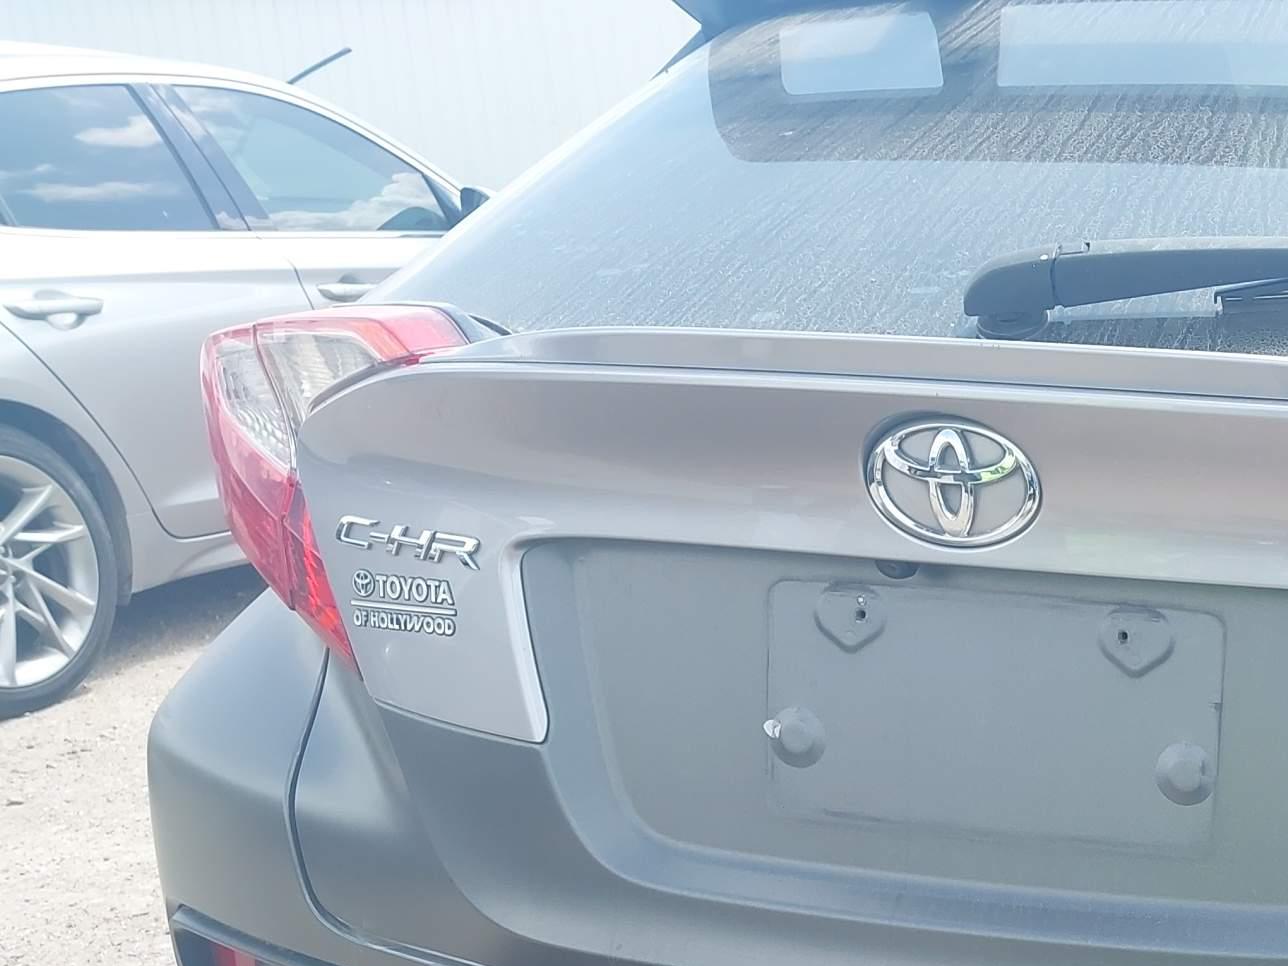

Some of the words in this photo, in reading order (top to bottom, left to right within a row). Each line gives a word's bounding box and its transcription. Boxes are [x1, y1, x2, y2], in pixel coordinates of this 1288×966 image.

[336, 515, 481, 571] C-HR
[375, 574, 455, 606] TOYOTA
[353, 608, 369, 627] OF
[370, 610, 456, 637] HOLLYWOOD
